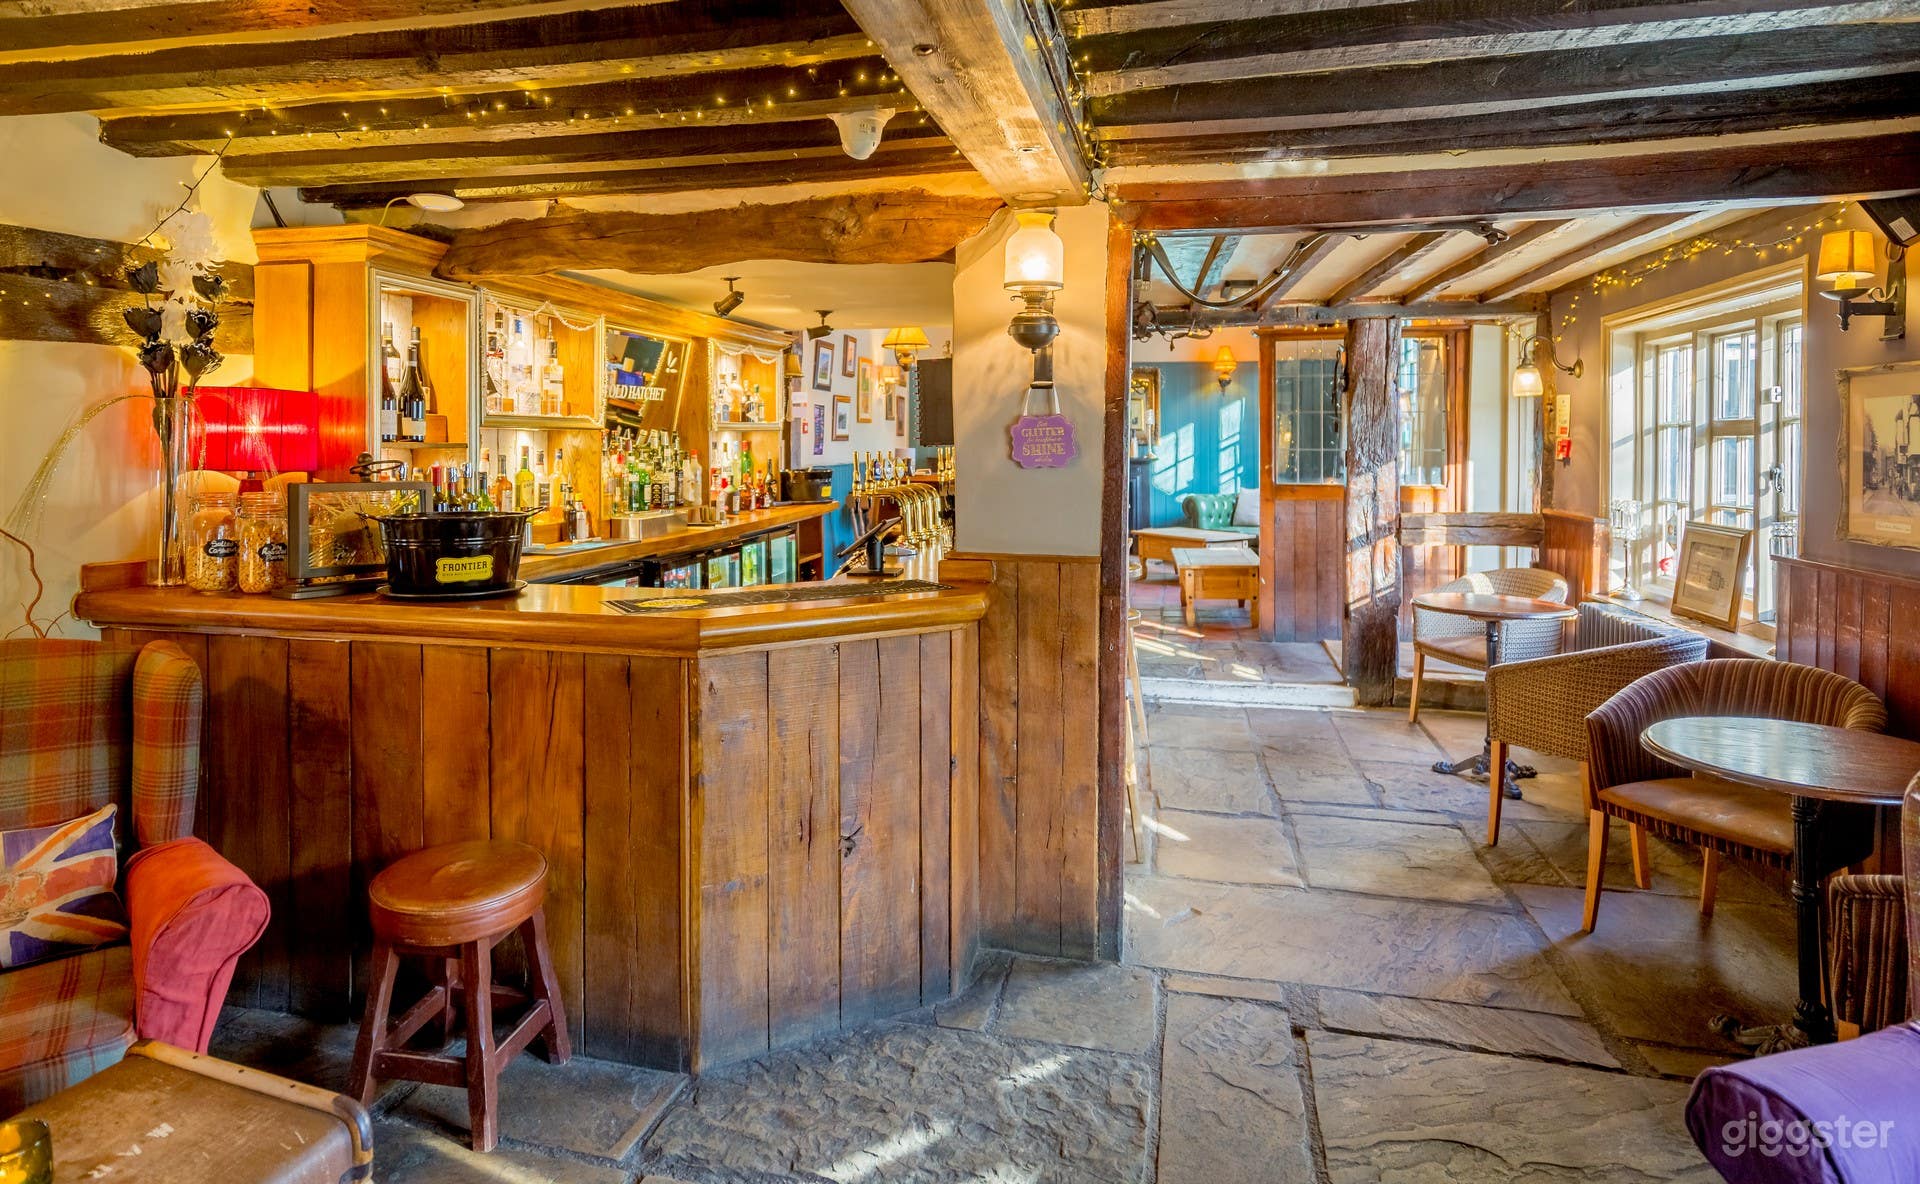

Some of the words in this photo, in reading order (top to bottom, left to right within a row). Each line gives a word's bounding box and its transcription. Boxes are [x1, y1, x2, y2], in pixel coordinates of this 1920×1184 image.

[609, 384, 628, 399] OLD
[628, 385, 667, 401] HATCHET
[1021, 427, 1065, 437] GLITTER
[1022, 443, 1066, 456] SHINE
[442, 561, 488, 572] FRONTIER
